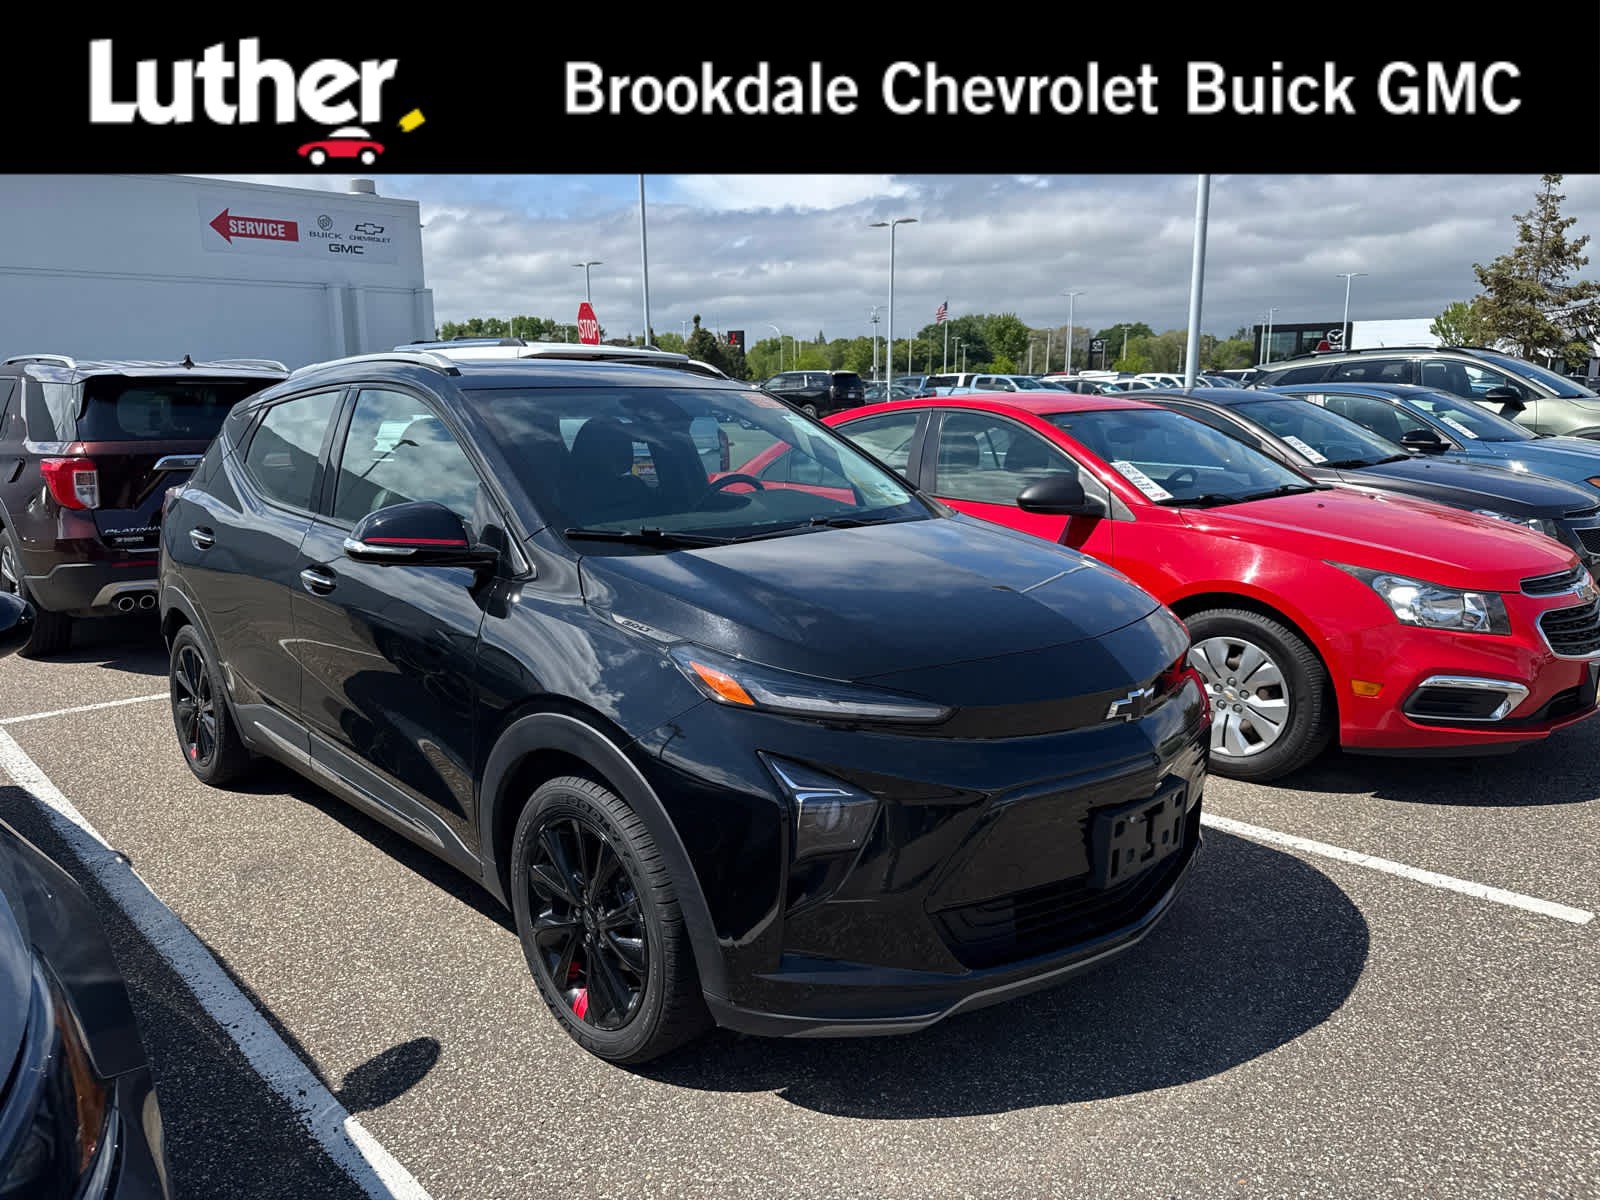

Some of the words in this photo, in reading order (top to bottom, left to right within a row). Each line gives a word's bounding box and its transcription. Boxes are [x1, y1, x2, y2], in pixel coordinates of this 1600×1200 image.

[228, 219, 286, 237] SERVICE
[309, 231, 343, 240] BUICK
[349, 234, 391, 244] CHEVROLET
[328, 243, 365, 255] GMC
[579, 319, 597, 339] STOP
